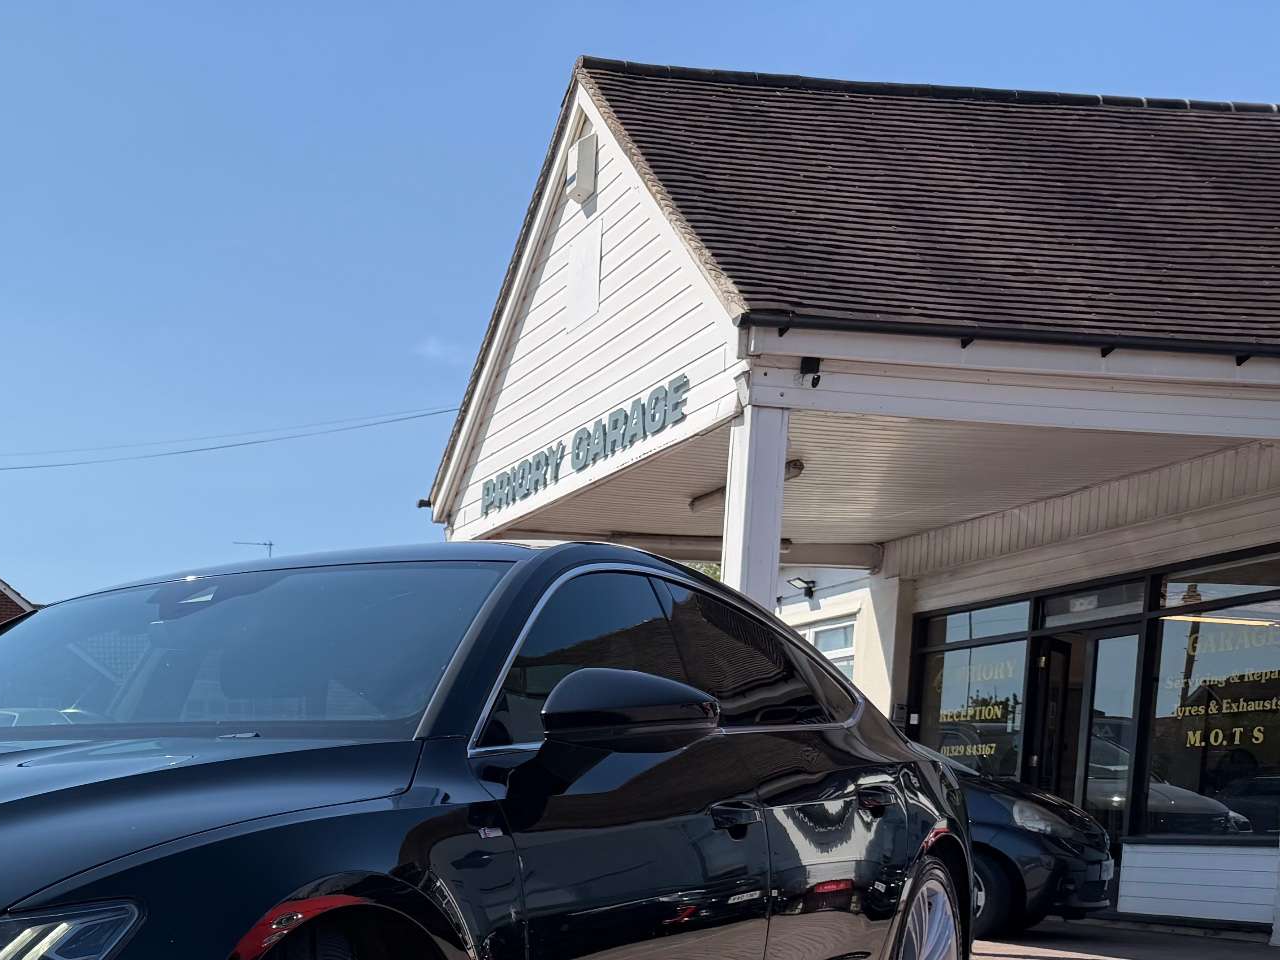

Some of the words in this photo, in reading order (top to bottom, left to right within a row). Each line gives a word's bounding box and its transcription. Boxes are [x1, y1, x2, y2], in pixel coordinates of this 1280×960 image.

[481, 440, 567, 518] PRIORY
[570, 372, 691, 473] GARAGE
[939, 704, 1003, 722] RECEPTION
[1208, 699, 1219, 714] &
